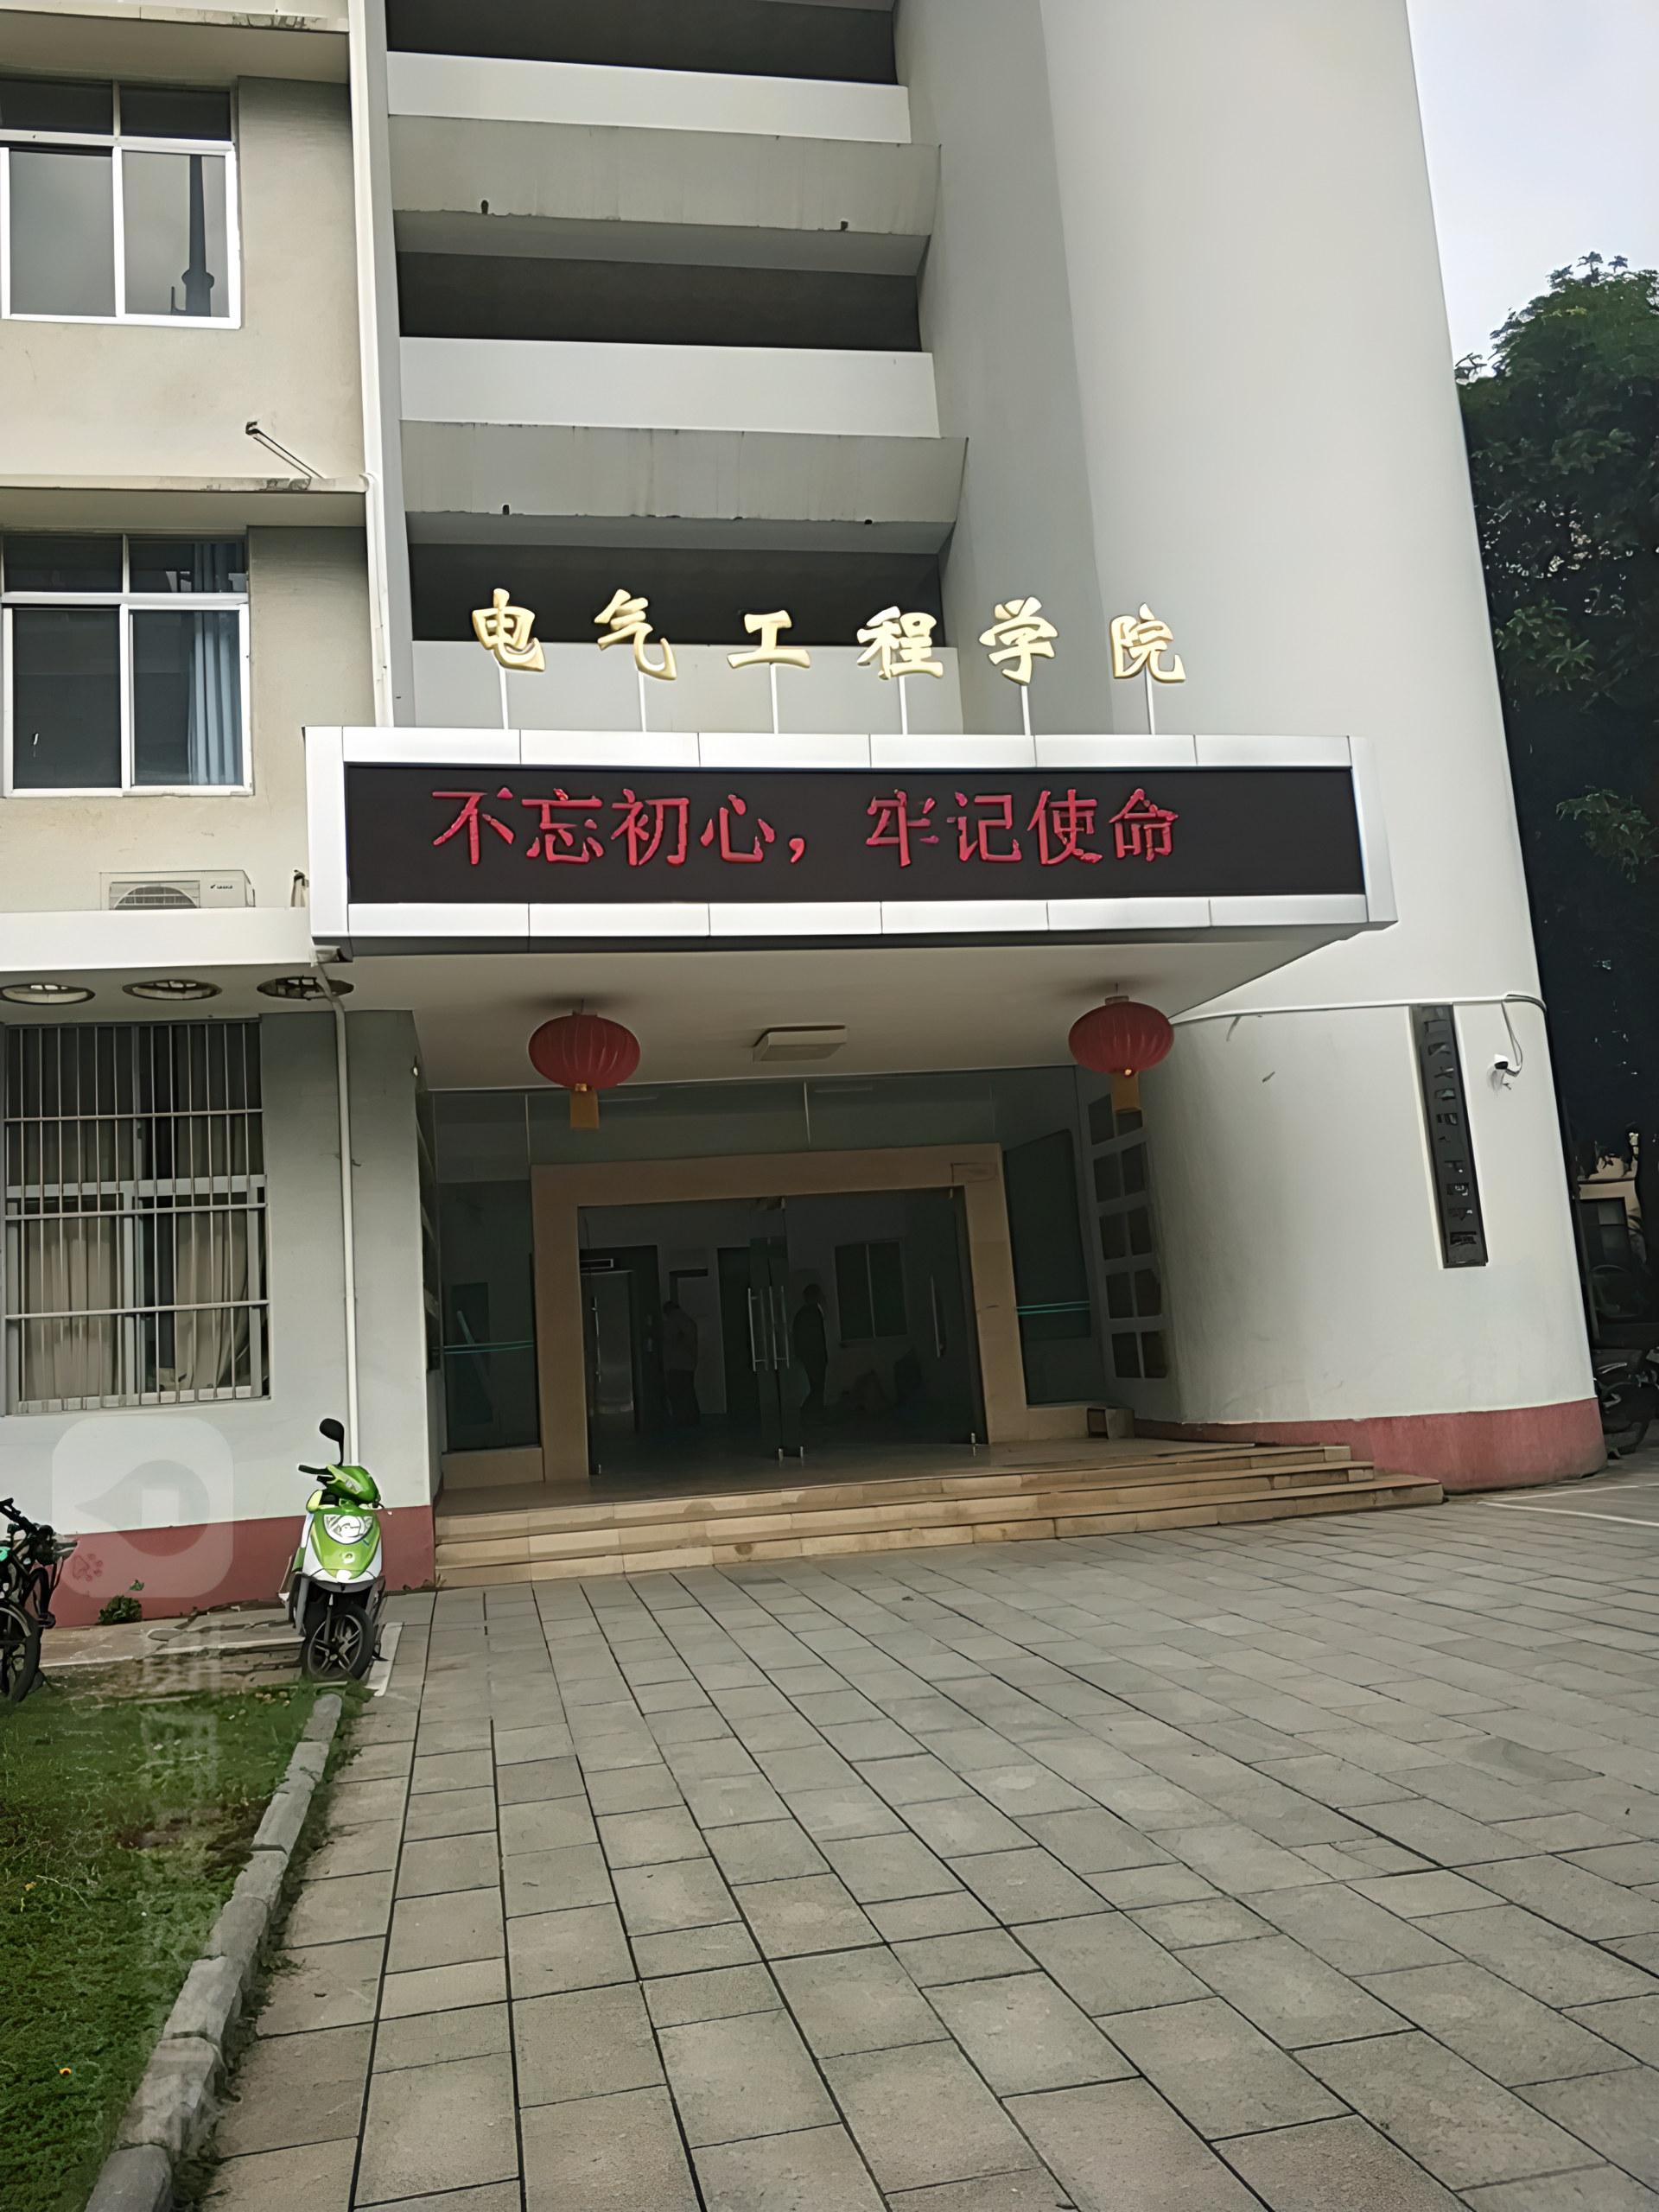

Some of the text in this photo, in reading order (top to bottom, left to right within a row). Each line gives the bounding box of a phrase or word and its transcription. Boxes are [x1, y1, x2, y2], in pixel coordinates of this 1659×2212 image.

[472, 588, 1186, 683] 电气工程学院
